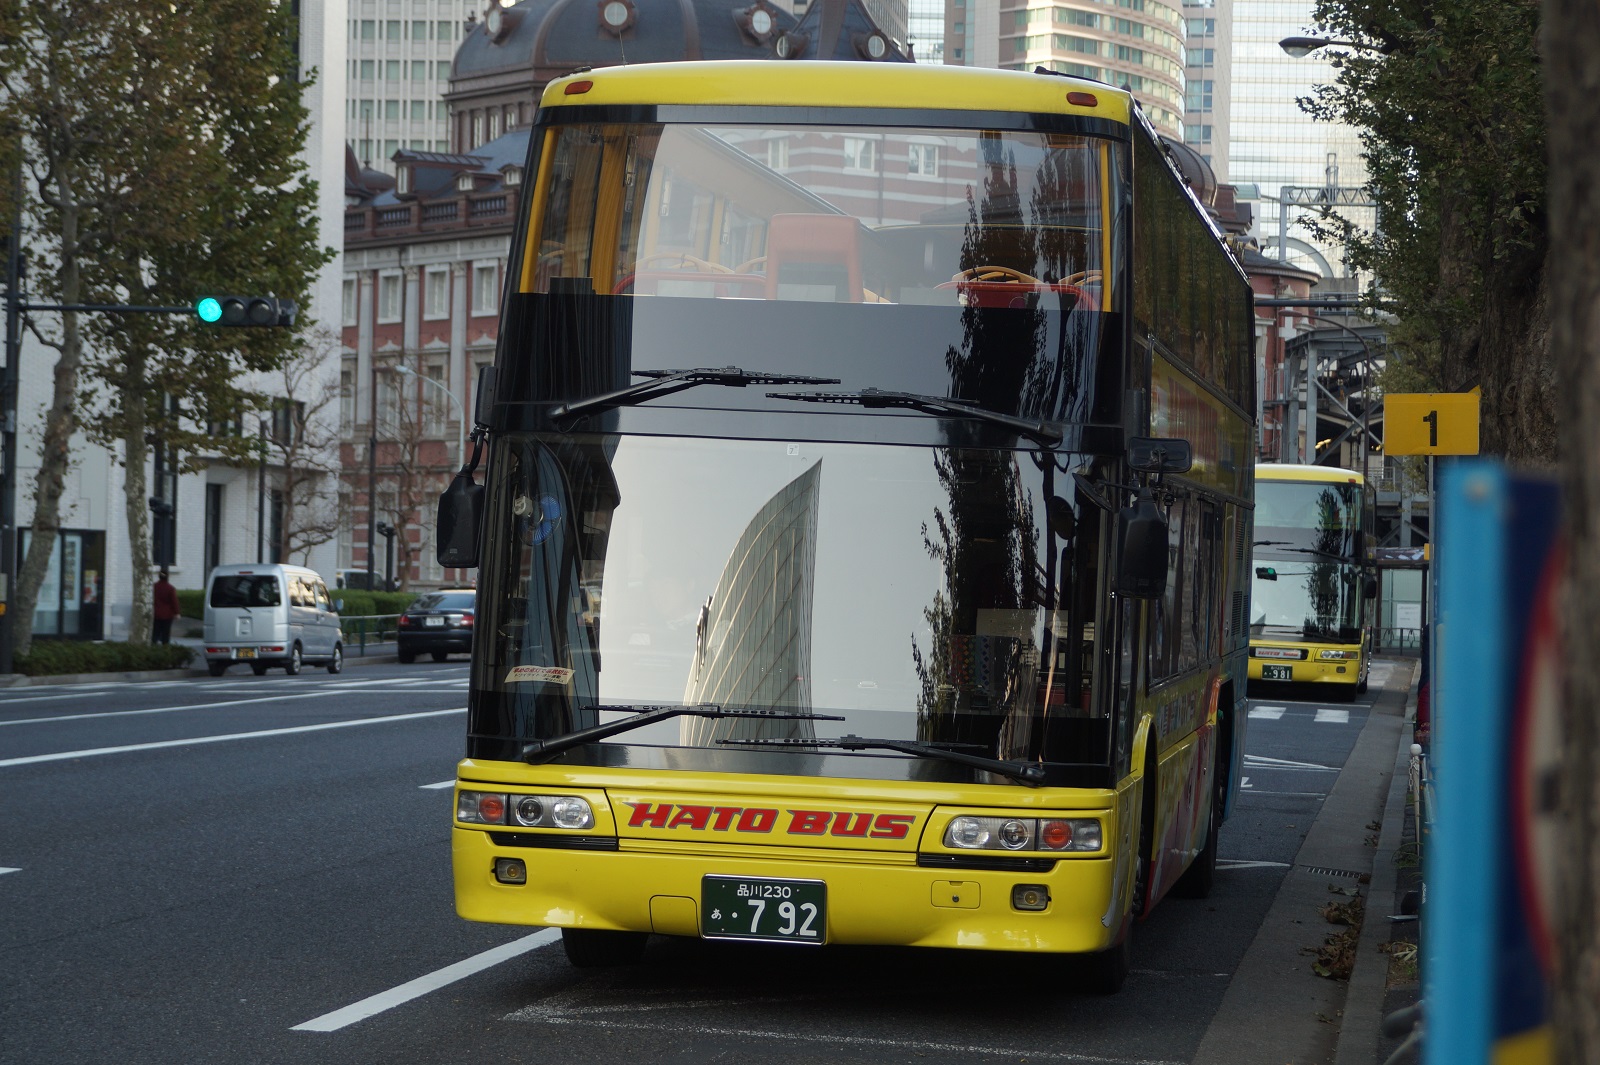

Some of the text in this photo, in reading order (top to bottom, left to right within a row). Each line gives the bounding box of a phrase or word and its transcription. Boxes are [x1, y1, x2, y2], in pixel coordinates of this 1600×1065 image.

[1423, 411, 1437, 446] 1
[622, 802, 916, 839] HATO BUS
[737, 884, 792, 898] 品川230
